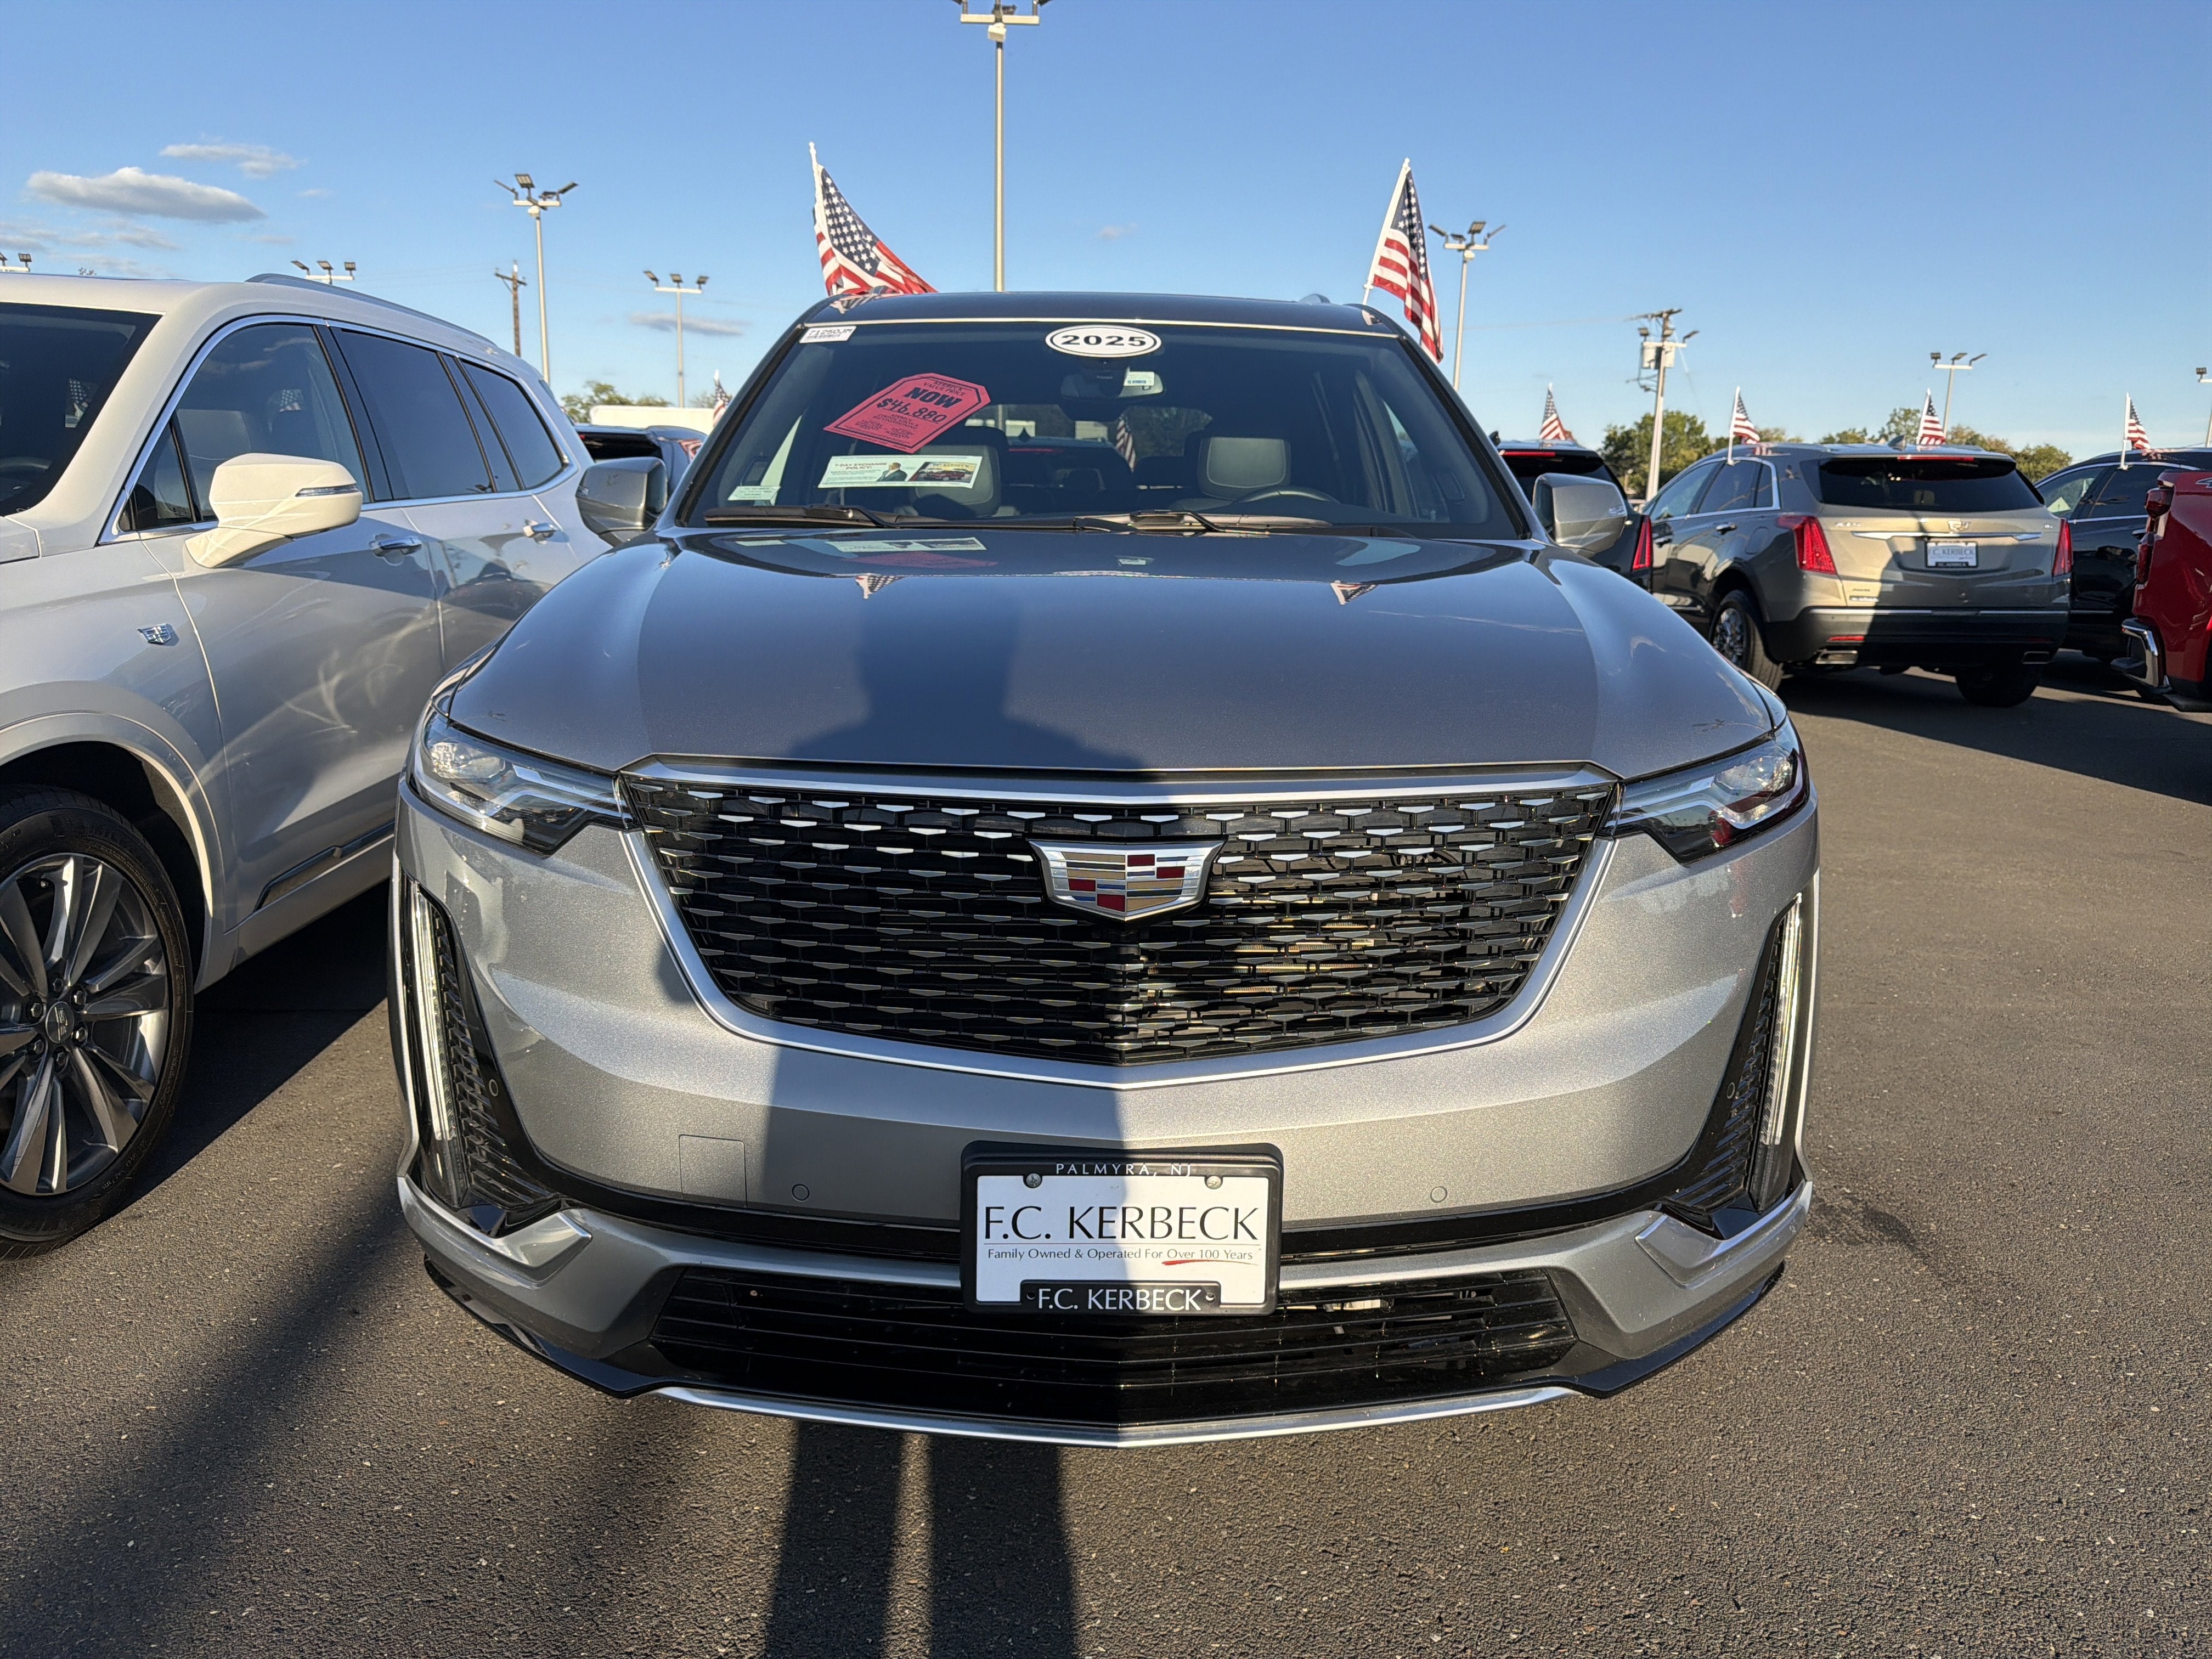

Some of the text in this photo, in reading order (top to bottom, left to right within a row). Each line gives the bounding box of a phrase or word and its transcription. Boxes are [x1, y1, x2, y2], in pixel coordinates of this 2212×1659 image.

[1061, 335, 1146, 347] 2025
[903, 387, 963, 409] NOW
[1056, 1163, 1191, 1177] PALMYRA, NJ
[985, 1206, 1259, 1240] F.C. KERBECK
[988, 1248, 1253, 1261] Family Owned & Operated For Over 100 Years
[1039, 1288, 1201, 1311] F.C. KERBECK
